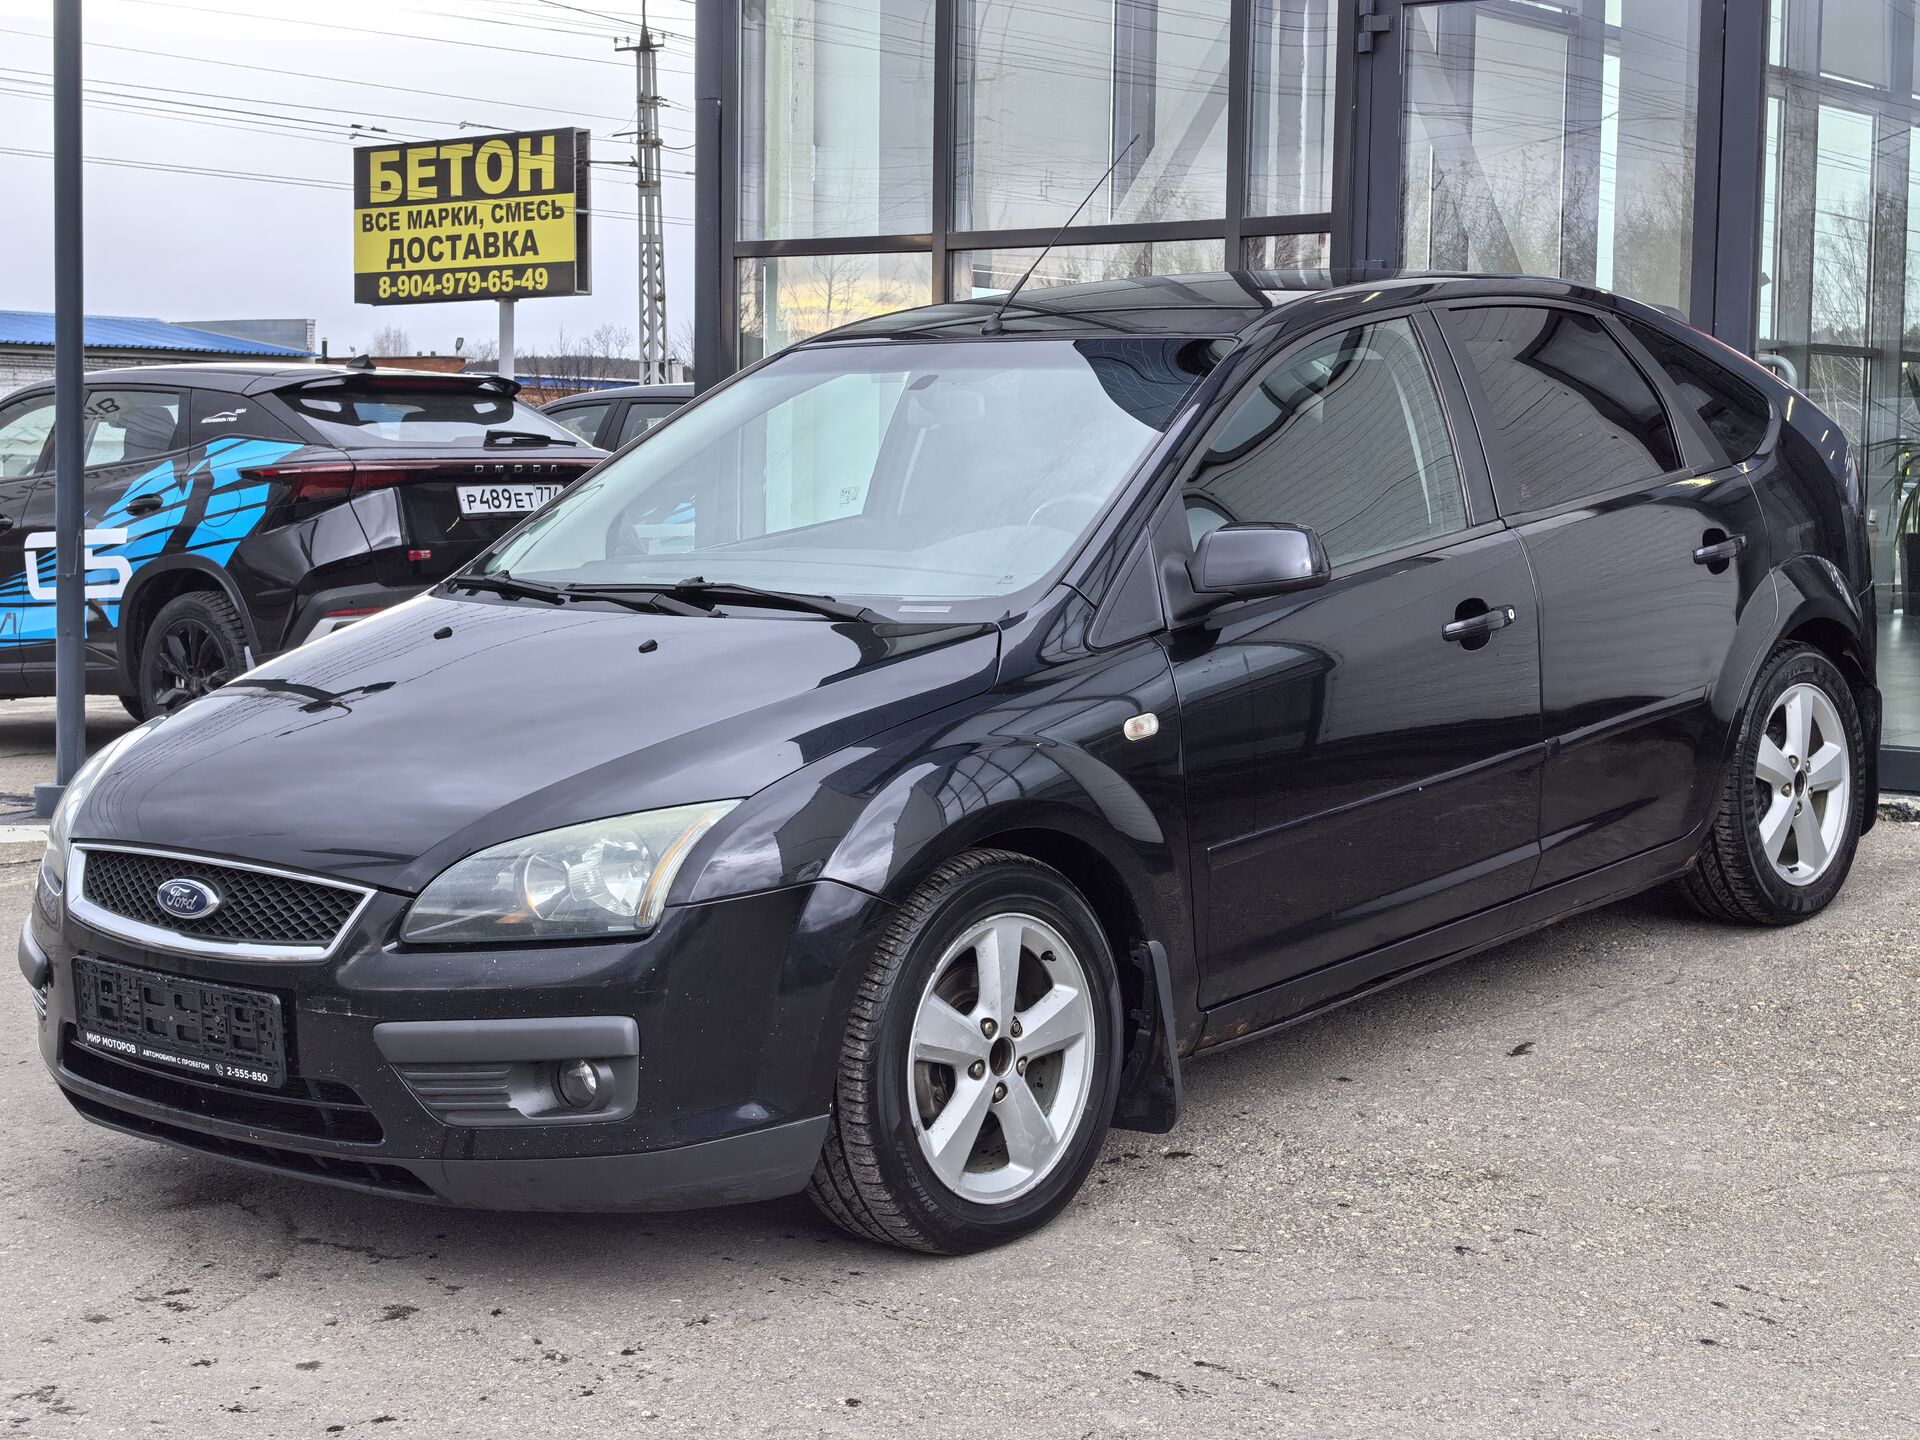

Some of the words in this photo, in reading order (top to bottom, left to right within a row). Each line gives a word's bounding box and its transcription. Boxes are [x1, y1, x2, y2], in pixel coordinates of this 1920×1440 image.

[370, 135, 555, 204] БЕТОН
[362, 211, 400, 233] ВСЕ
[407, 205, 484, 230] МАРКИ,
[490, 199, 565, 224] СМЕСЬ
[386, 229, 539, 270] ДОСТАВКА
[378, 267, 549, 299] 8-904-979-65-49
[166, 885, 198, 910] Ford
[86, 1032, 101, 1045] МИР
[102, 1036, 137, 1054] МОТОРОВ
[142, 1049, 177, 1063] АВТОМОБИЛИ
[177, 1056, 181, 1064] С
[181, 1058, 210, 1071] ПРОБЕГОМ
[226, 1067, 268, 1083] 2-555-850
